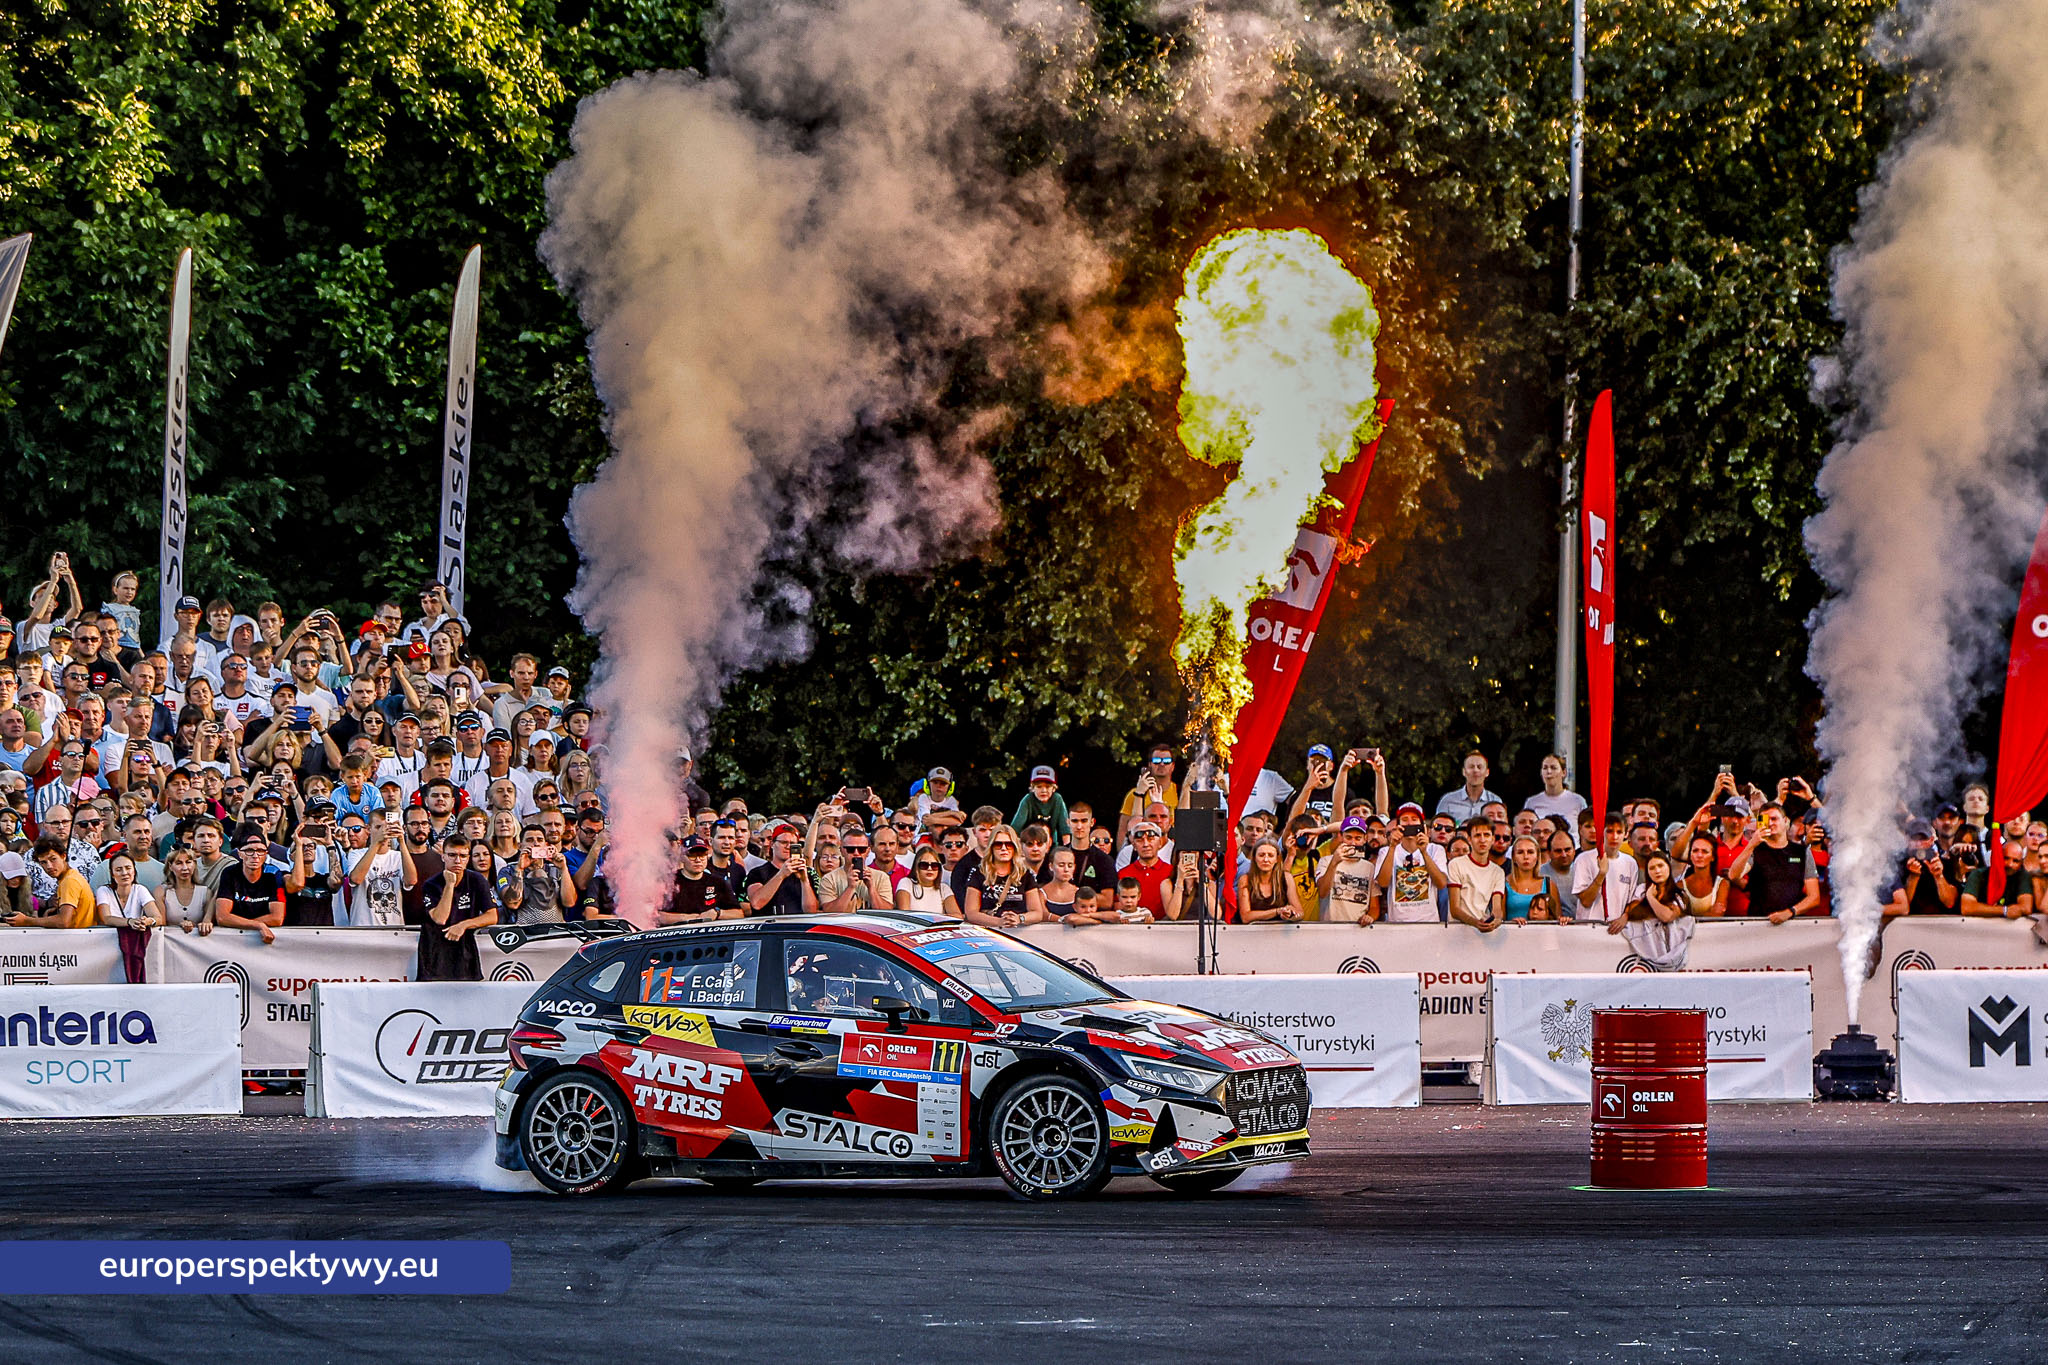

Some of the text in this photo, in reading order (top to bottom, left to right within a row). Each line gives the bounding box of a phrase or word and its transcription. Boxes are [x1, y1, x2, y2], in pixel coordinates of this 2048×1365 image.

[644, 928, 697, 939] TRANSPORT
[707, 923, 756, 933] LOGISTICS
[39, 951, 78, 972] ŚLĄSKI
[641, 966, 674, 1003] 11
[945, 979, 970, 998] VALENS
[689, 990, 745, 1005] I.Bacigál
[1420, 996, 1473, 1015] ADION
[536, 1000, 597, 1017] YACCO
[0, 1005, 158, 1047] nteria
[781, 1017, 828, 1028] Europartner
[1096, 1031, 1148, 1047] YACCO
[1294, 1034, 1376, 1055] Turystyki
[1707, 1024, 1767, 1046] rystyki
[886, 1053, 898, 1061] OIL
[887, 1041, 959, 1073] ORLEN 11
[1232, 1047, 1287, 1066] TYRES
[26, 1058, 132, 1085] SPORT
[621, 1048, 744, 1095] MRF
[867, 1068, 932, 1081] FIA ERC Championship
[633, 1084, 723, 1121] TYRES
[1632, 1091, 1674, 1103] ORLEN
[1632, 1104, 1649, 1113] OIL
[1238, 1103, 1299, 1134] STALCO
[784, 1112, 913, 1159] STALCO
[1177, 1140, 1213, 1153] MRF
[1253, 1142, 1286, 1158] YACCO
